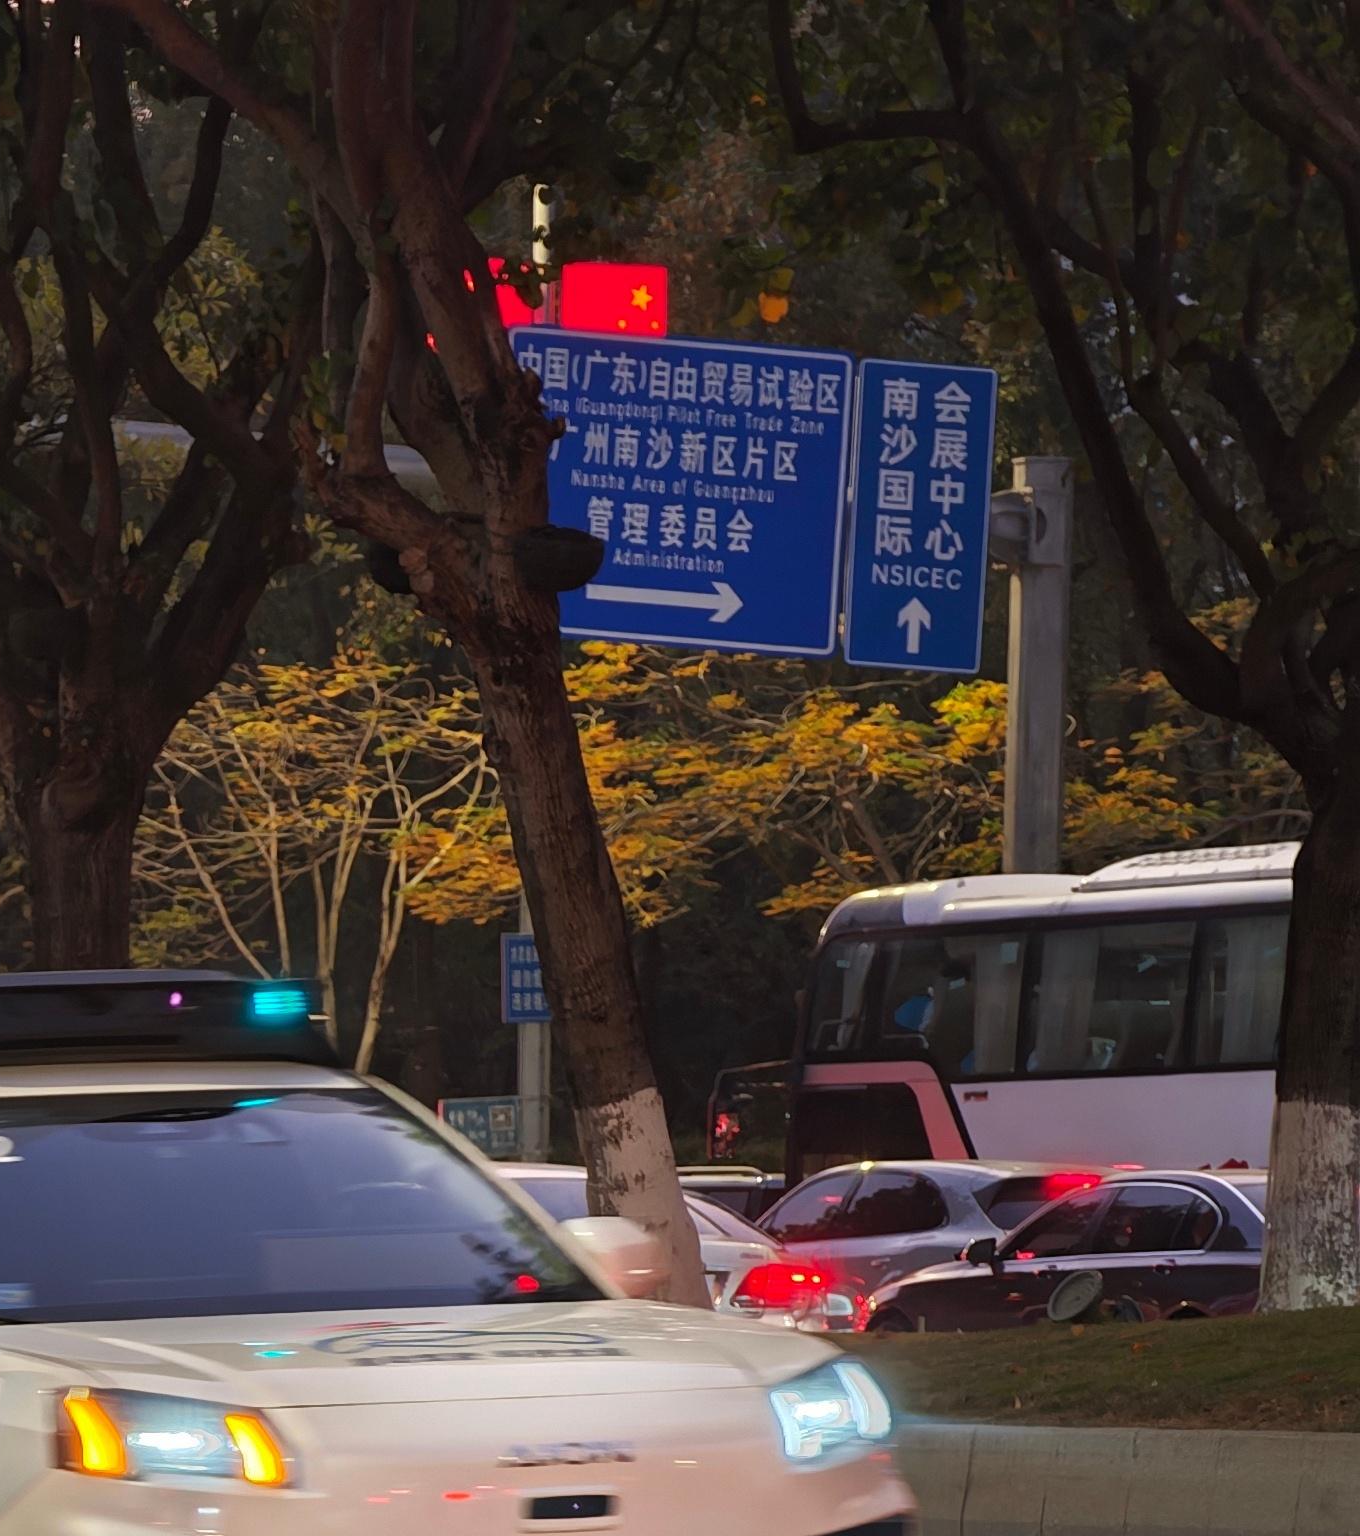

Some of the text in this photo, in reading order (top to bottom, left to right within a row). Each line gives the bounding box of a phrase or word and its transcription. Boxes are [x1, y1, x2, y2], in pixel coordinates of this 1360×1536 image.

[706, 408, 737, 428] Free
[744, 411, 784, 432] Trade
[790, 415, 825, 436] Zone
[874, 377, 920, 557] 南沙国际
[924, 380, 972, 561] 会展中心
[570, 468, 775, 505] Nansha Area of Guangzhou
[586, 495, 754, 553] 管理委员会
[612, 547, 725, 574] Administration
[871, 562, 963, 591] NSICEC
